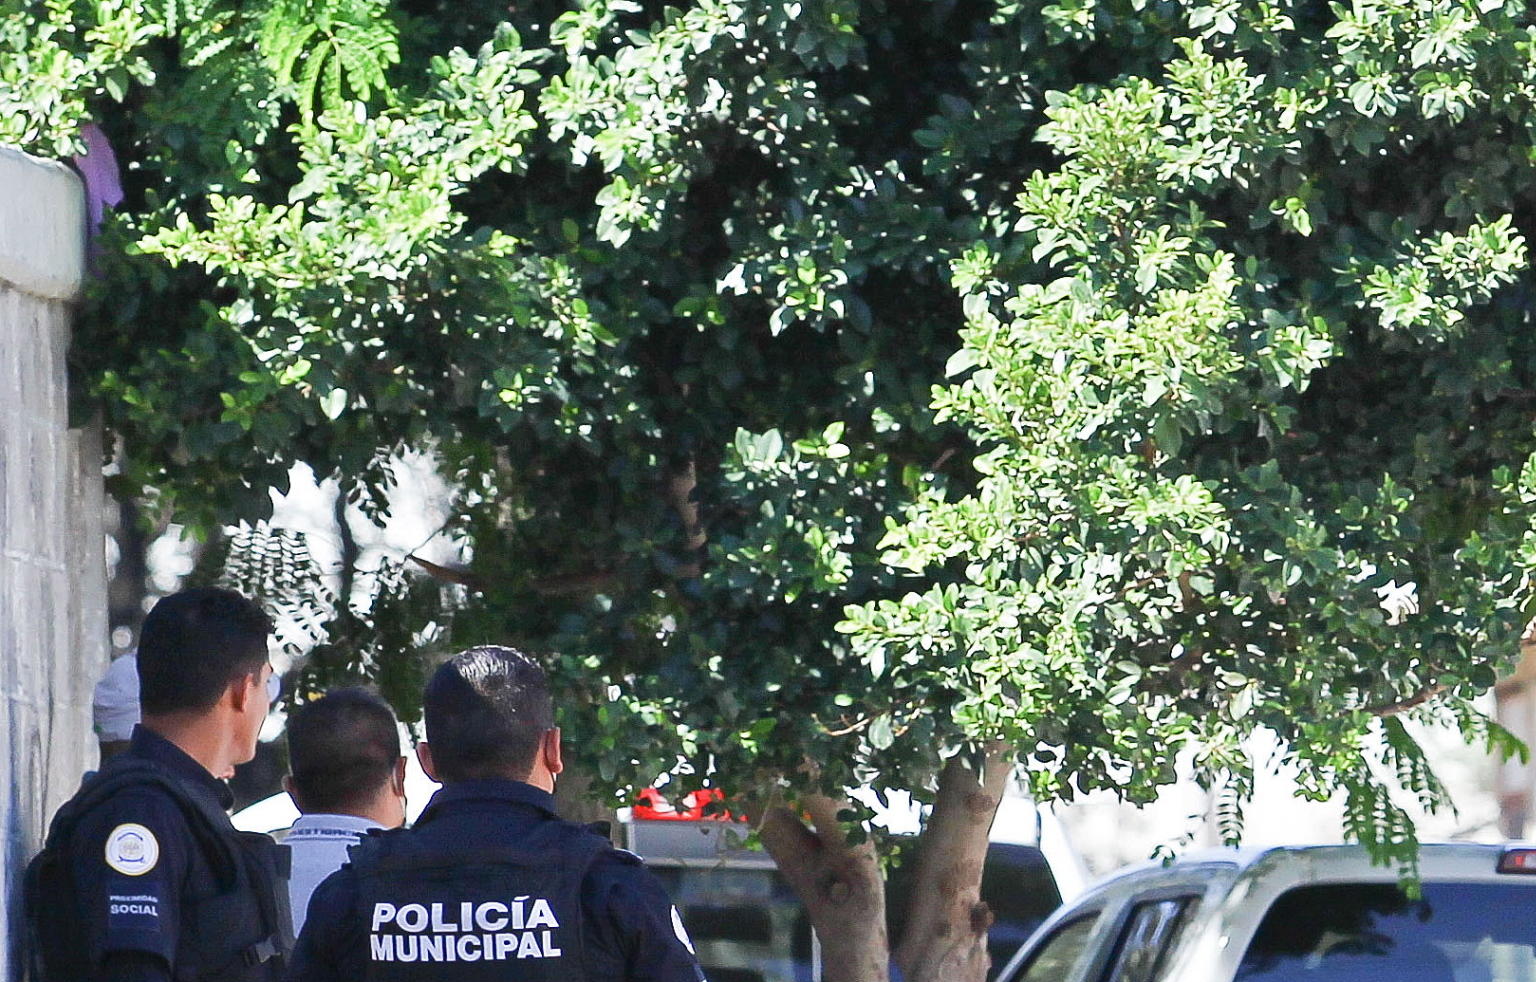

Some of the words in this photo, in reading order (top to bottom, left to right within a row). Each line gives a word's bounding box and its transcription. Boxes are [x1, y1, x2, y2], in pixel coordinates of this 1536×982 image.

[110, 904, 158, 917] SOCIAL
[371, 896, 559, 932] POLICÍA
[370, 930, 561, 962] MUNICIPAL
